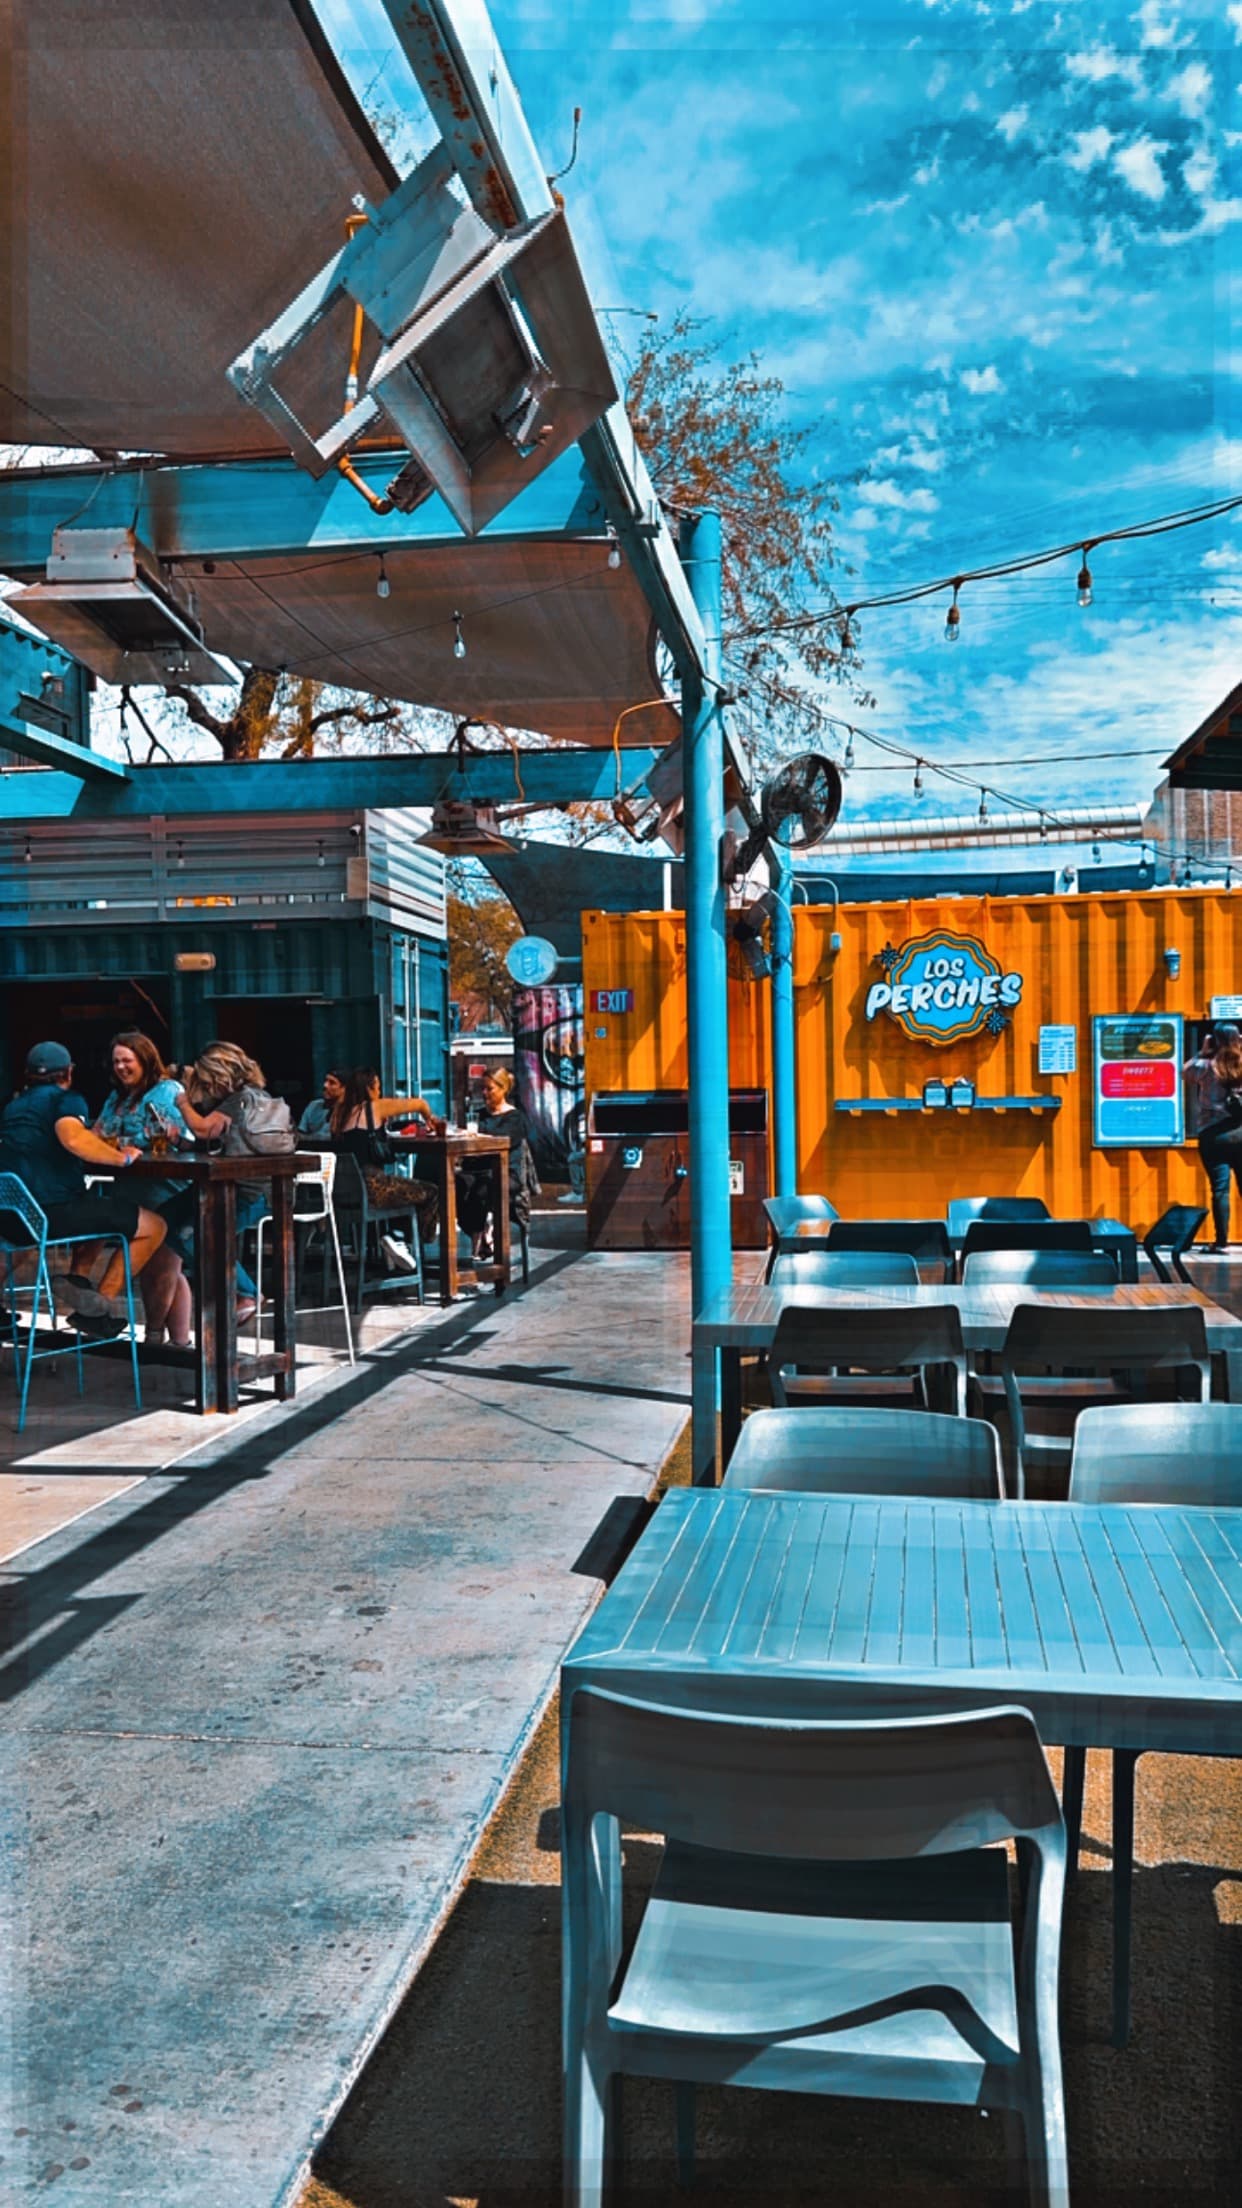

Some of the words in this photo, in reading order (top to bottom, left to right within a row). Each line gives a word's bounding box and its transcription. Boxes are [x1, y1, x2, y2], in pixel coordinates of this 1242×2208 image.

[924, 958, 964, 980] LOS
[598, 991, 628, 1012] EXIT
[866, 973, 1022, 1021] PERCHES
